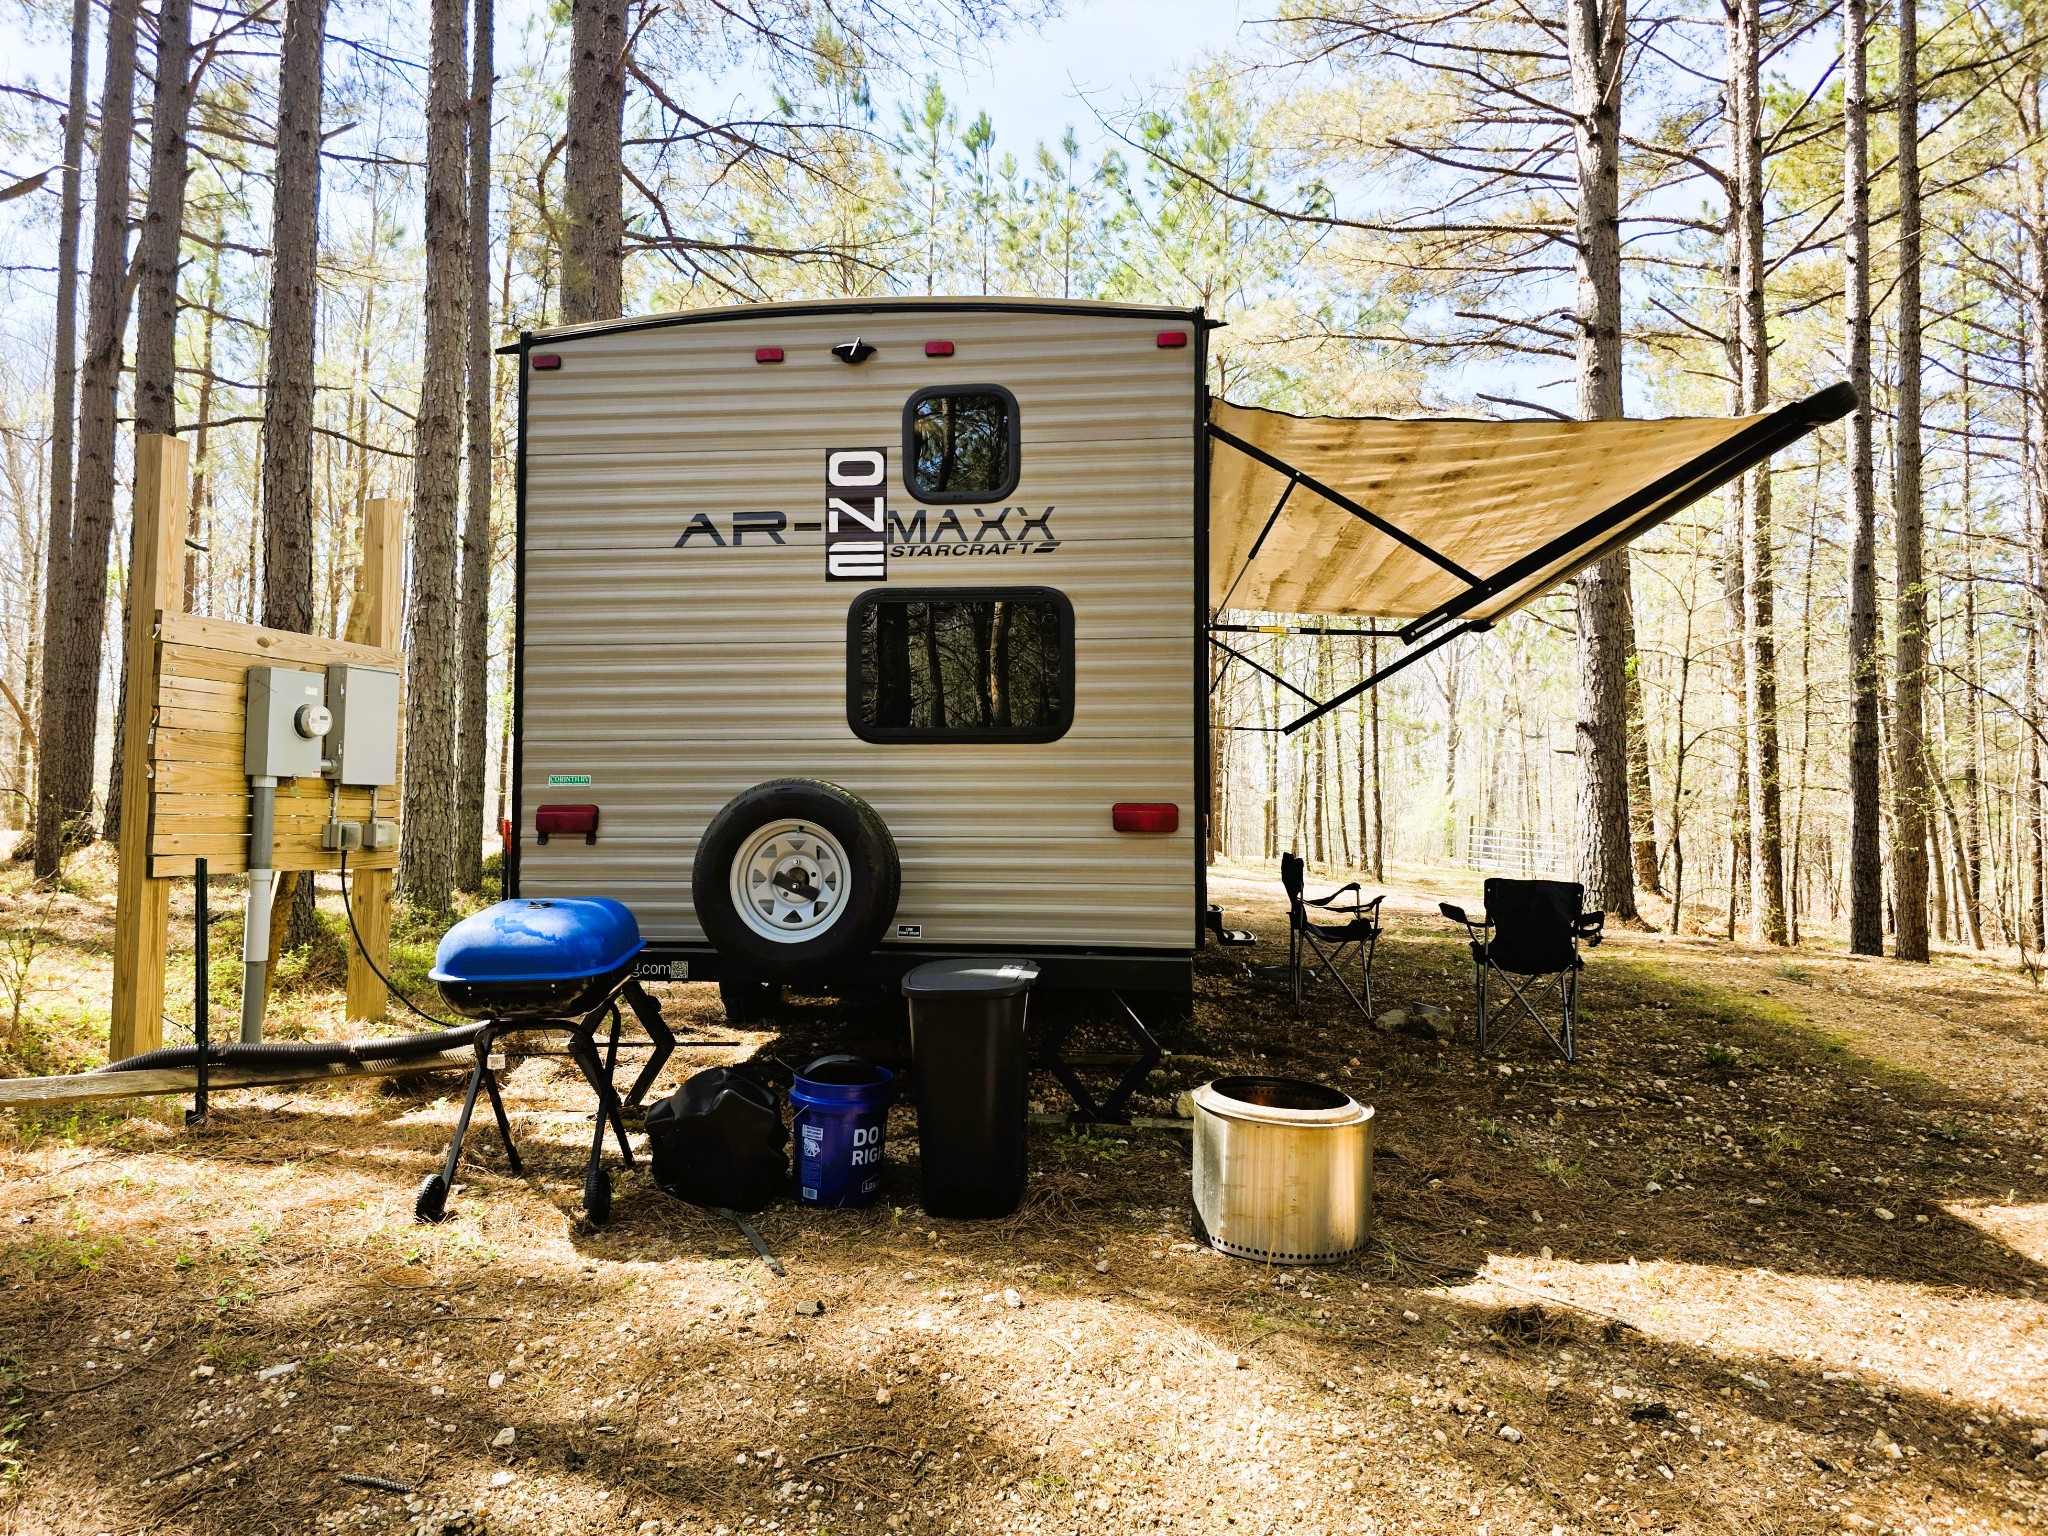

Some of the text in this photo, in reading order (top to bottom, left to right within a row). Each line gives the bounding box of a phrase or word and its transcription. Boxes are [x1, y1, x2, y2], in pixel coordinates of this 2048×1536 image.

[828, 450, 884, 577] ONE
[888, 506, 1056, 543] MAXX
[890, 543, 1034, 558] STARCRAFT
[550, 775, 579, 783] CORINTH
[853, 1126, 879, 1146] DO
